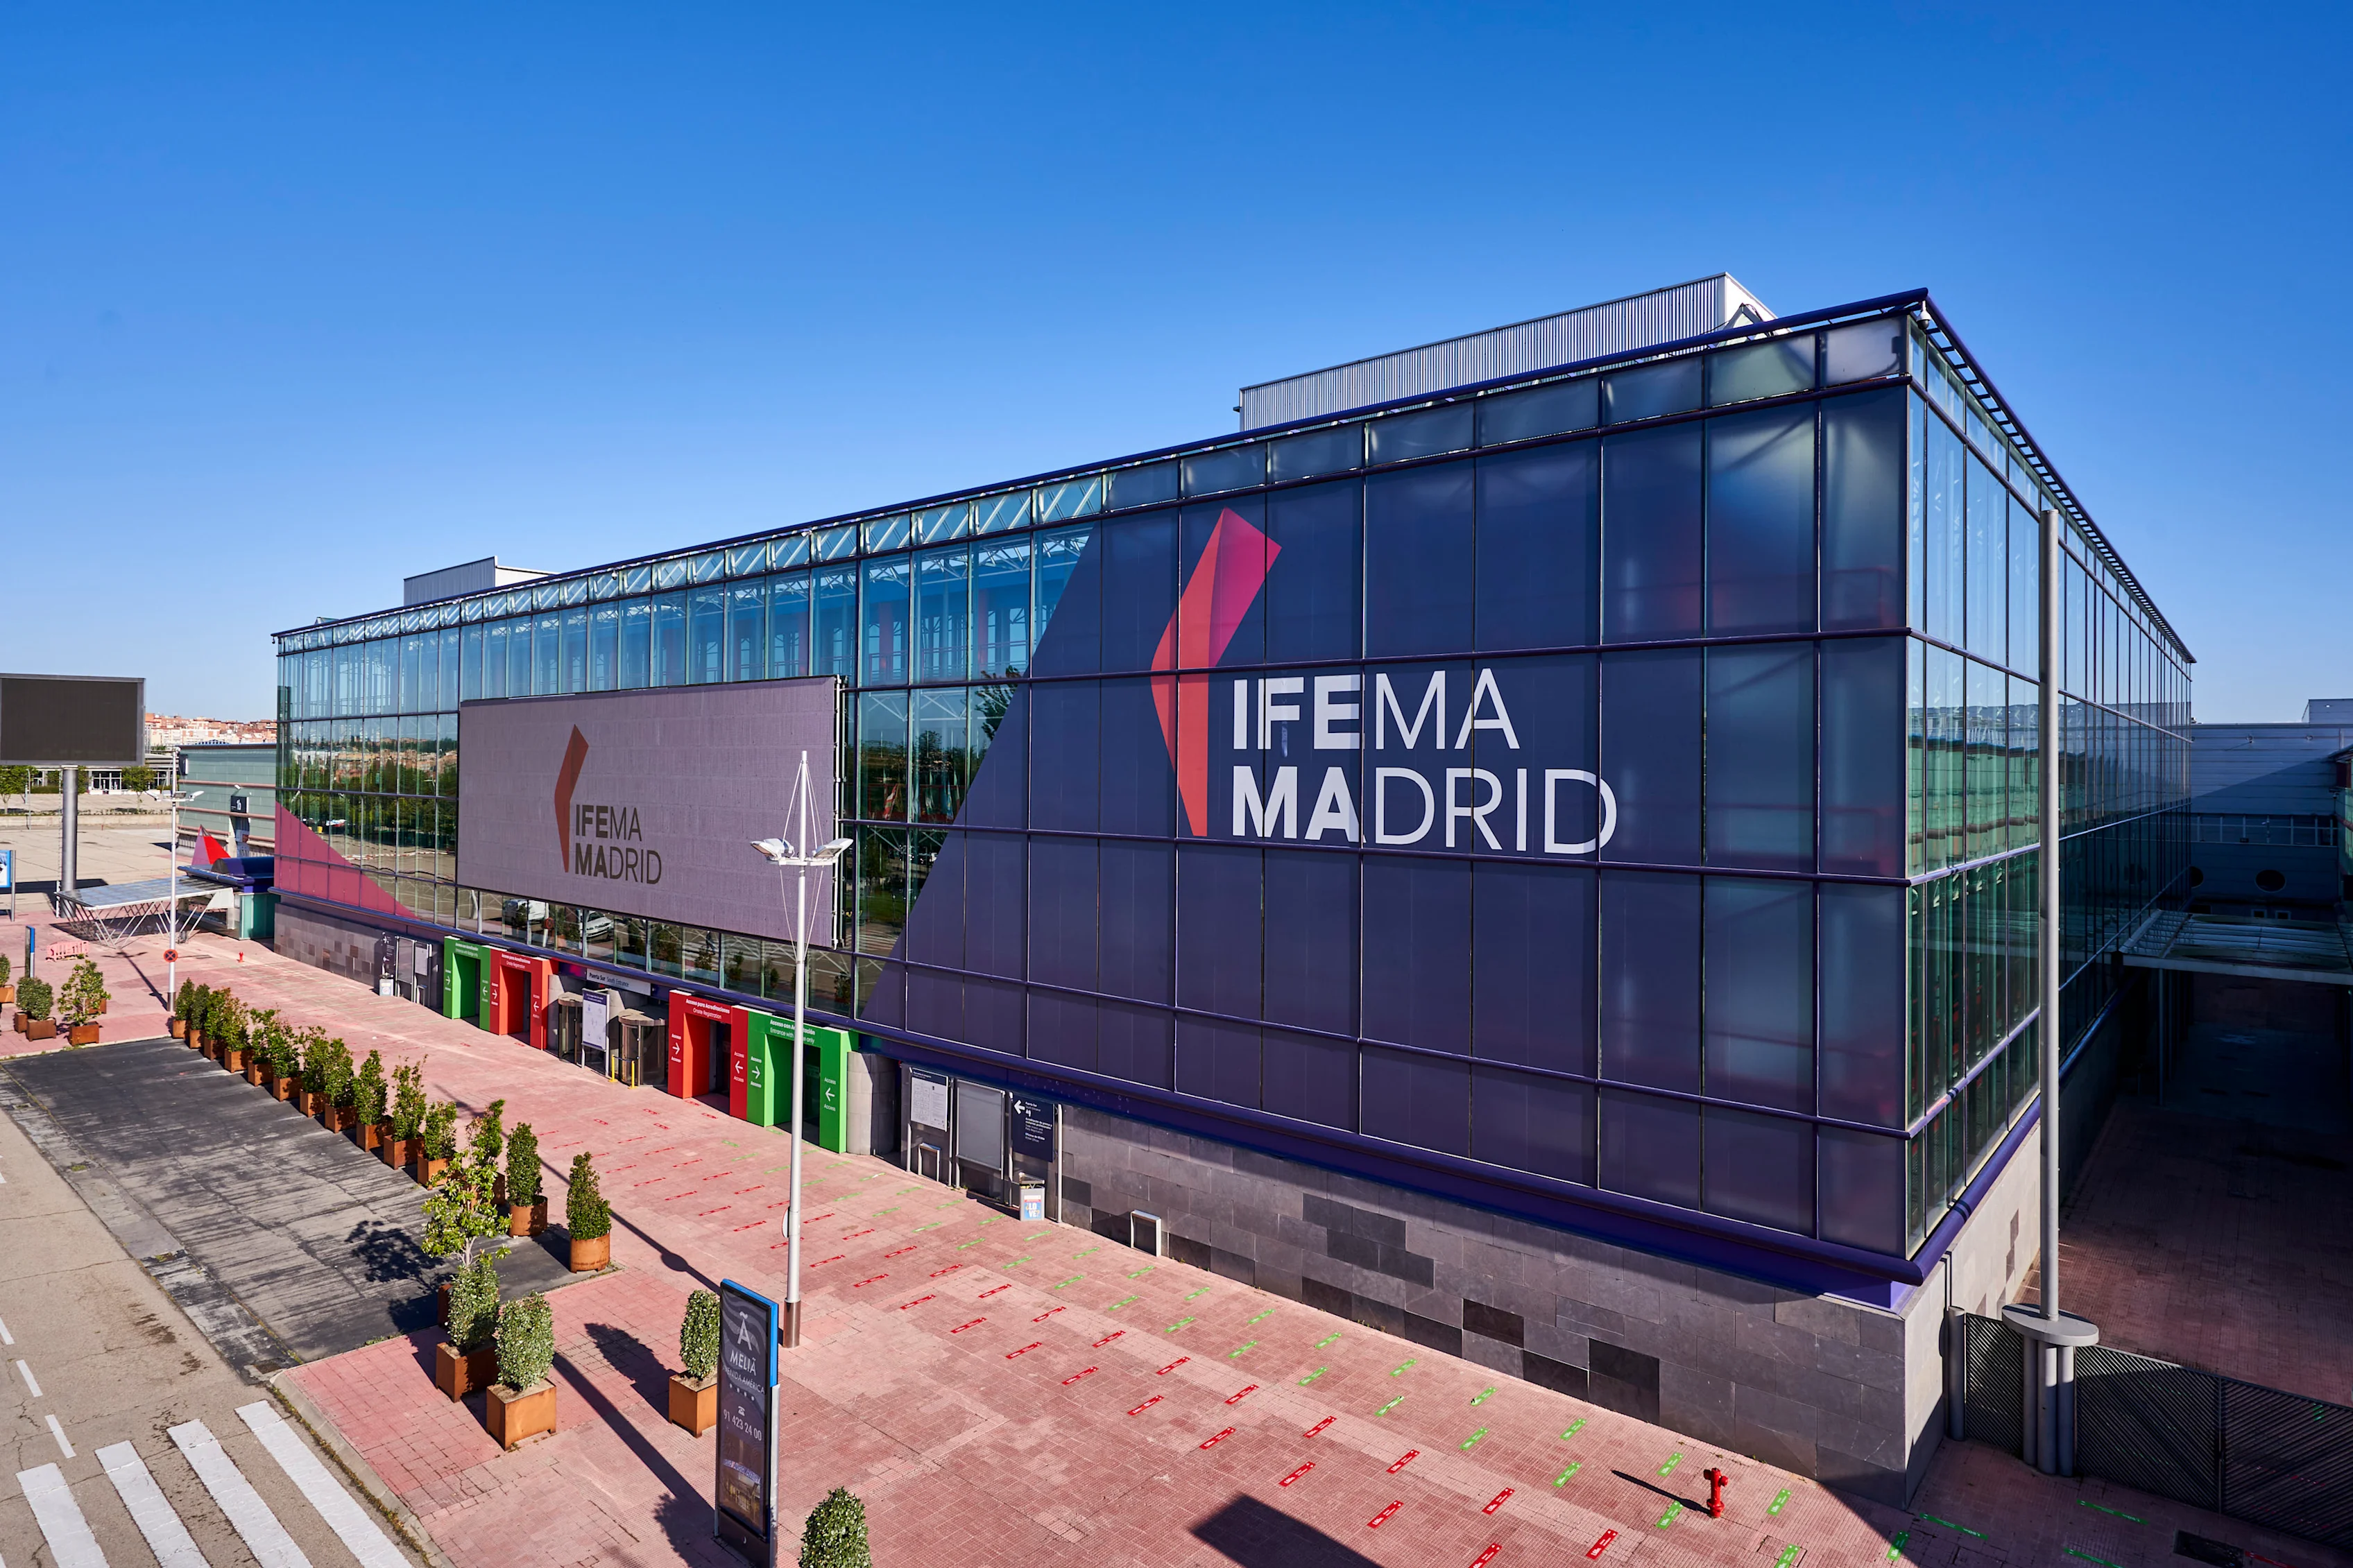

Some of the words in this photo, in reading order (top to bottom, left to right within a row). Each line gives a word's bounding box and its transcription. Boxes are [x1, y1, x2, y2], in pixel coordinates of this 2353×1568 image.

[1233, 668, 1521, 750] IFEMA
[575, 804, 642, 842] IFEMA
[1232, 765, 1618, 855] MADRID
[574, 842, 662, 885] MADRID
[770, 1019, 783, 1028] Acceso
[770, 1028, 786, 1036] Entrance
[723, 1409, 730, 1422] 91
[732, 1415, 744, 1430] 423
[744, 1422, 753, 1436] 24
[753, 1427, 762, 1441] 00
